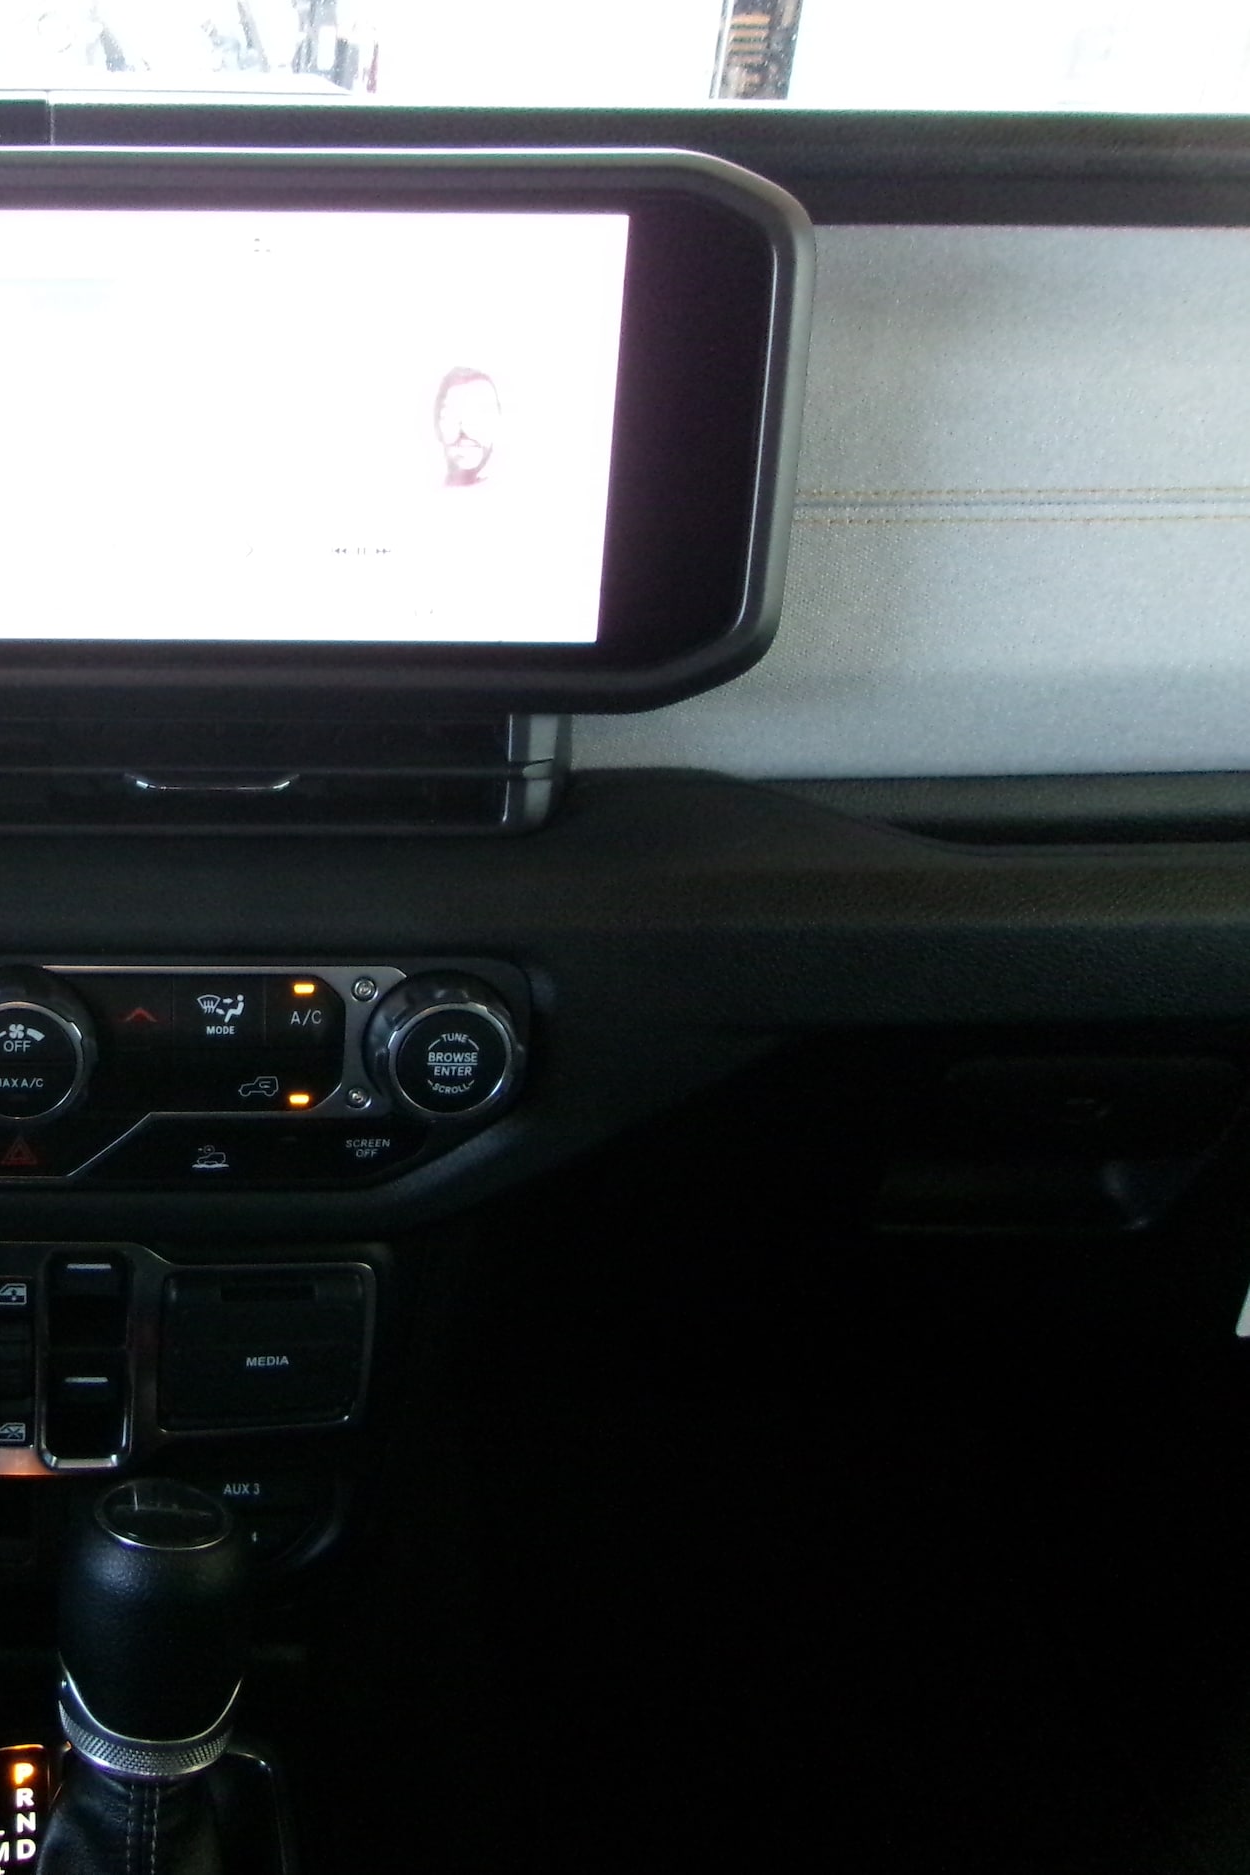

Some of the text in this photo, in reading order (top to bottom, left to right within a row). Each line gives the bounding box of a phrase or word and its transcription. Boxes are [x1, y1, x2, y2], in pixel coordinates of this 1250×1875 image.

[290, 1010, 323, 1026] A/C
[206, 1025, 236, 1036] MODE
[441, 1032, 469, 1044] TUNE
[3, 1040, 32, 1053] OFF
[427, 1051, 479, 1064] BROWSE
[433, 1065, 473, 1078] ENTER
[20, 1077, 45, 1089] A/C
[432, 1081, 471, 1096] SCROLL
[345, 1138, 391, 1149] SCREEN
[355, 1148, 380, 1159] OFF
[246, 1355, 291, 1368] MEDIA
[223, 1483, 251, 1496] AUX
[14, 1762, 34, 1785] P
[15, 1787, 36, 1808] R
[15, 1811, 37, 1833] N
[15, 1838, 37, 1860] D
